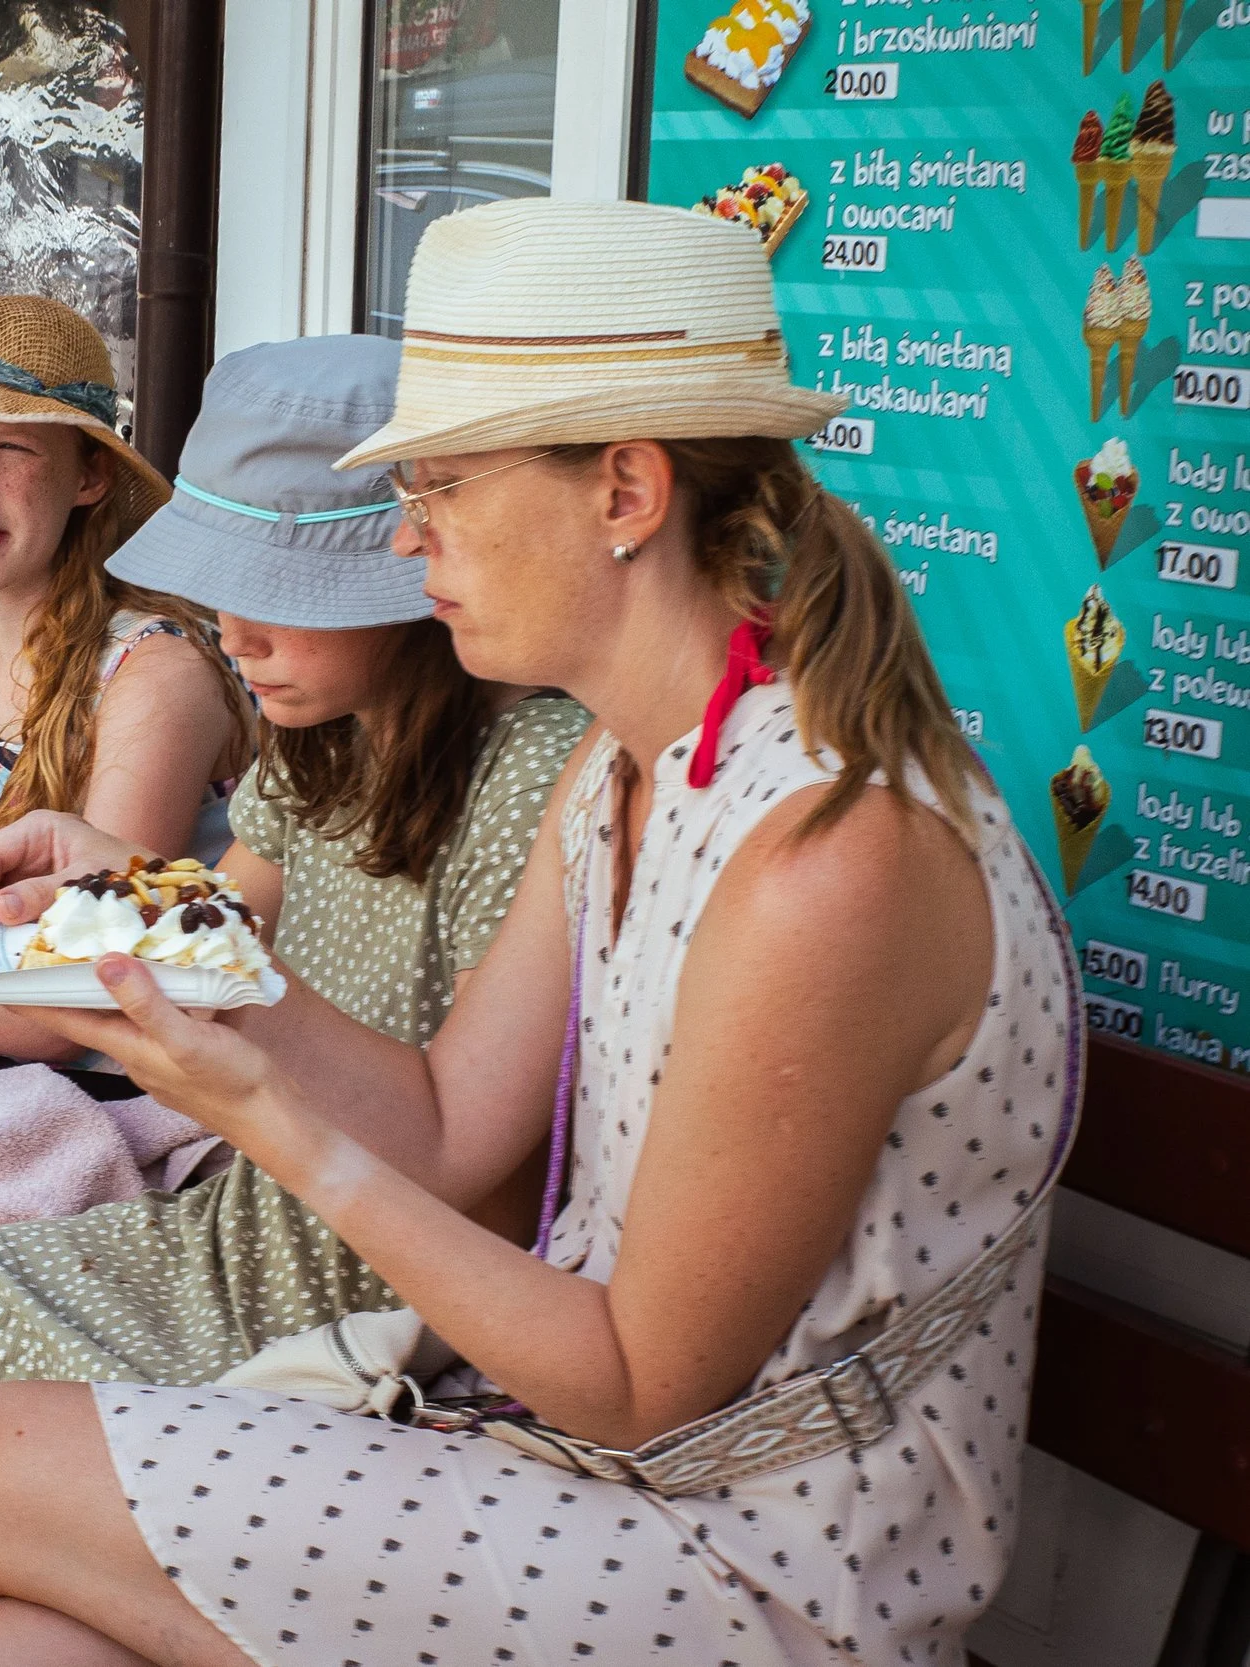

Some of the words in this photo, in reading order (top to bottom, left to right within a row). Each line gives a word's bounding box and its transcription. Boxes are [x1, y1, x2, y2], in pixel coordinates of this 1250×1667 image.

[837, 19, 848, 56] i
[853, 10, 1039, 57] brzoskwiniami
[1207, 109, 1234, 137] w
[830, 160, 846, 185] z
[908, 147, 1027, 194] śmietaną
[826, 192, 837, 229] i
[842, 195, 957, 232] owocami
[821, 240, 878, 267] 24,00
[1185, 281, 1205, 307] z
[818, 333, 835, 357] z
[895, 329, 1013, 378] śmietaną
[814, 369, 825, 393] i
[830, 369, 990, 419] truskawkami
[1173, 369, 1241, 404] 10,00
[1168, 447, 1228, 493] lody
[882, 509, 998, 563] śmietaną
[1165, 502, 1184, 527] z
[1151, 612, 1209, 660] lody
[1149, 668, 1166, 692] z
[1136, 782, 1194, 830] lody
[1201, 796, 1243, 838] lub
[1133, 837, 1151, 860] z
[1154, 1011, 1223, 1064] kawa
